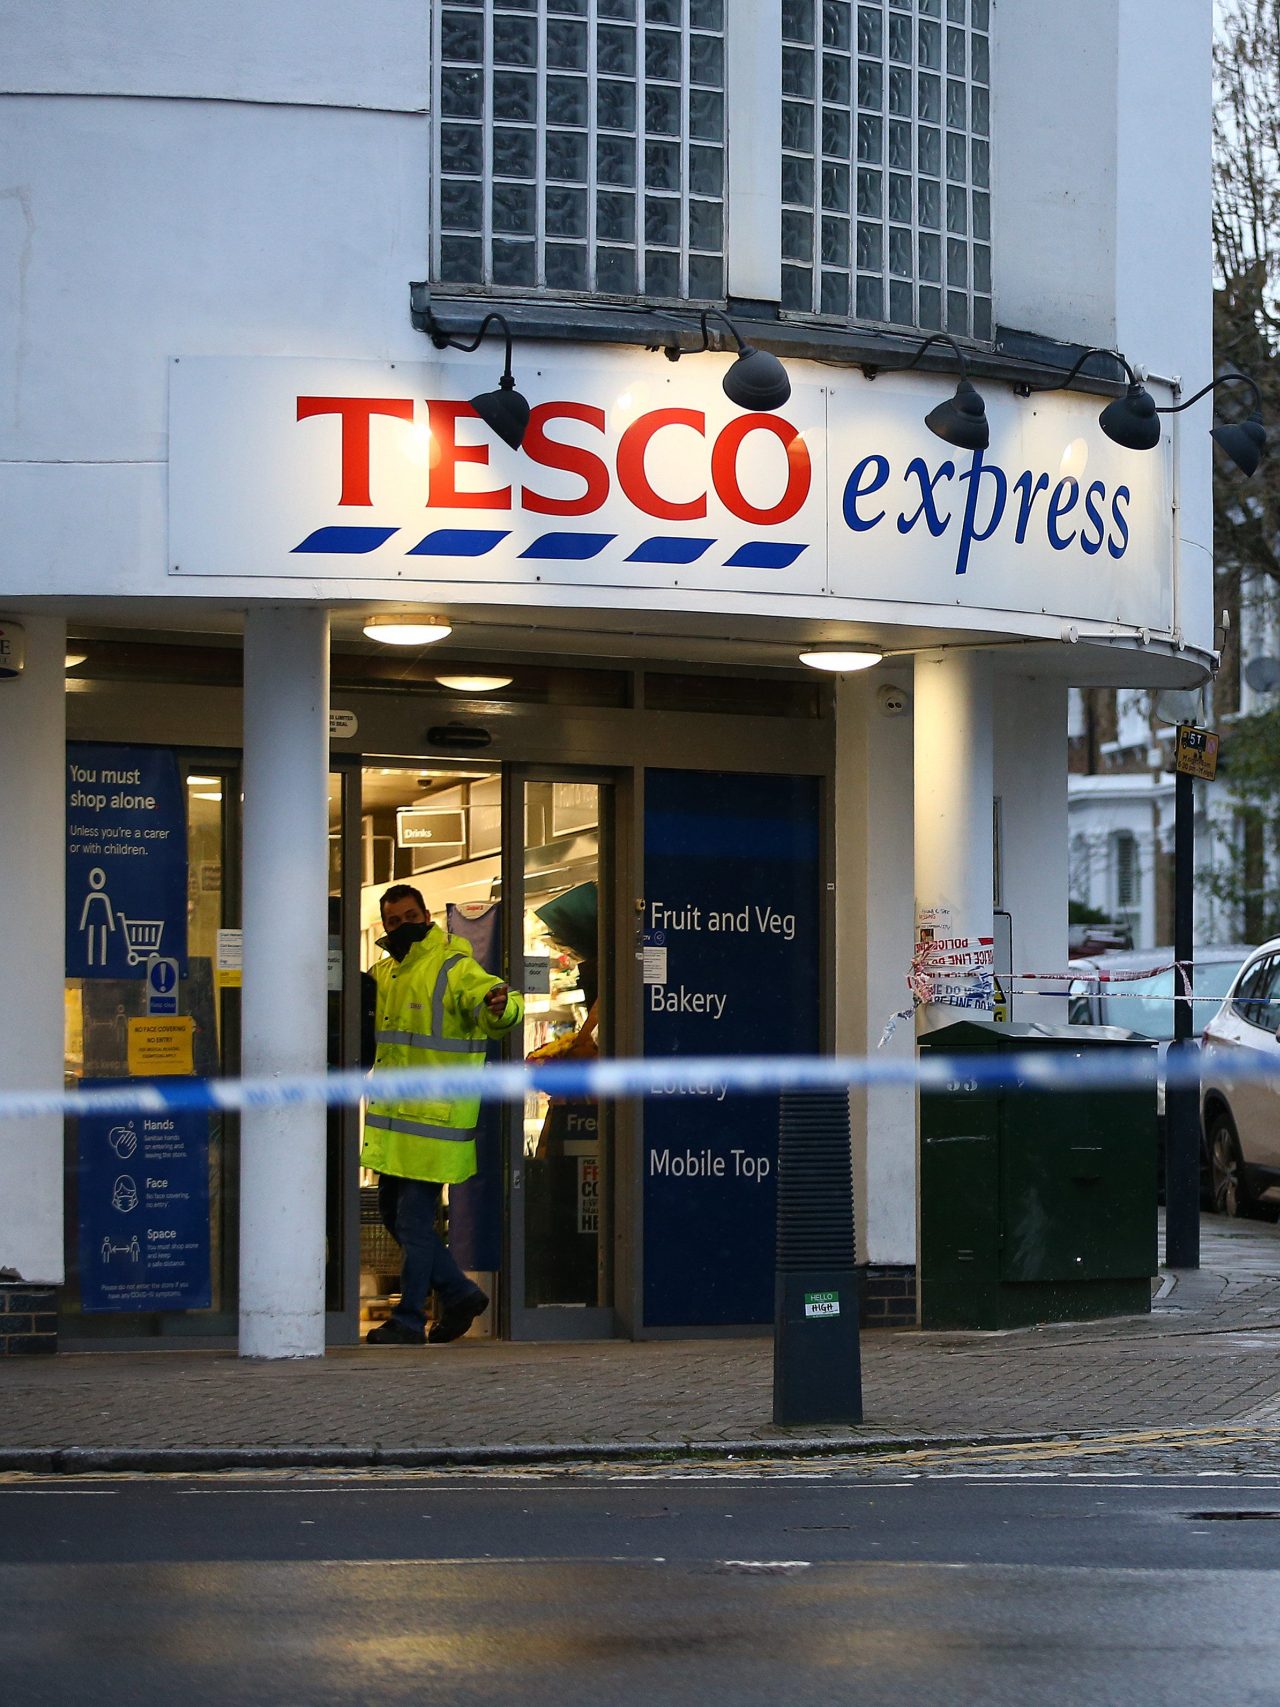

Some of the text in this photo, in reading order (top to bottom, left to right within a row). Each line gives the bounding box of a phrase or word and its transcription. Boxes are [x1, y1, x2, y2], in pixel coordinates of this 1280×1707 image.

[297, 396, 812, 525] TESCO
[842, 449, 1131, 575] express
[70, 765, 141, 785] You must
[71, 790, 106, 812] shop
[70, 825, 170, 839] Unless you're a carer
[404, 828, 432, 839] Drinks
[70, 842, 149, 855] or with children.
[652, 902, 796, 940] Fruit and Veg
[948, 953, 971, 965] LINE
[651, 985, 727, 1019] Bakery
[144, 1119, 175, 1130] Hands
[650, 1149, 770, 1183] Mobile Top
[146, 1177, 168, 1188] Face
[147, 1228, 177, 1241] Space
[810, 1293, 833, 1301] HELLO
[811, 1303, 834, 1313] HIGH
